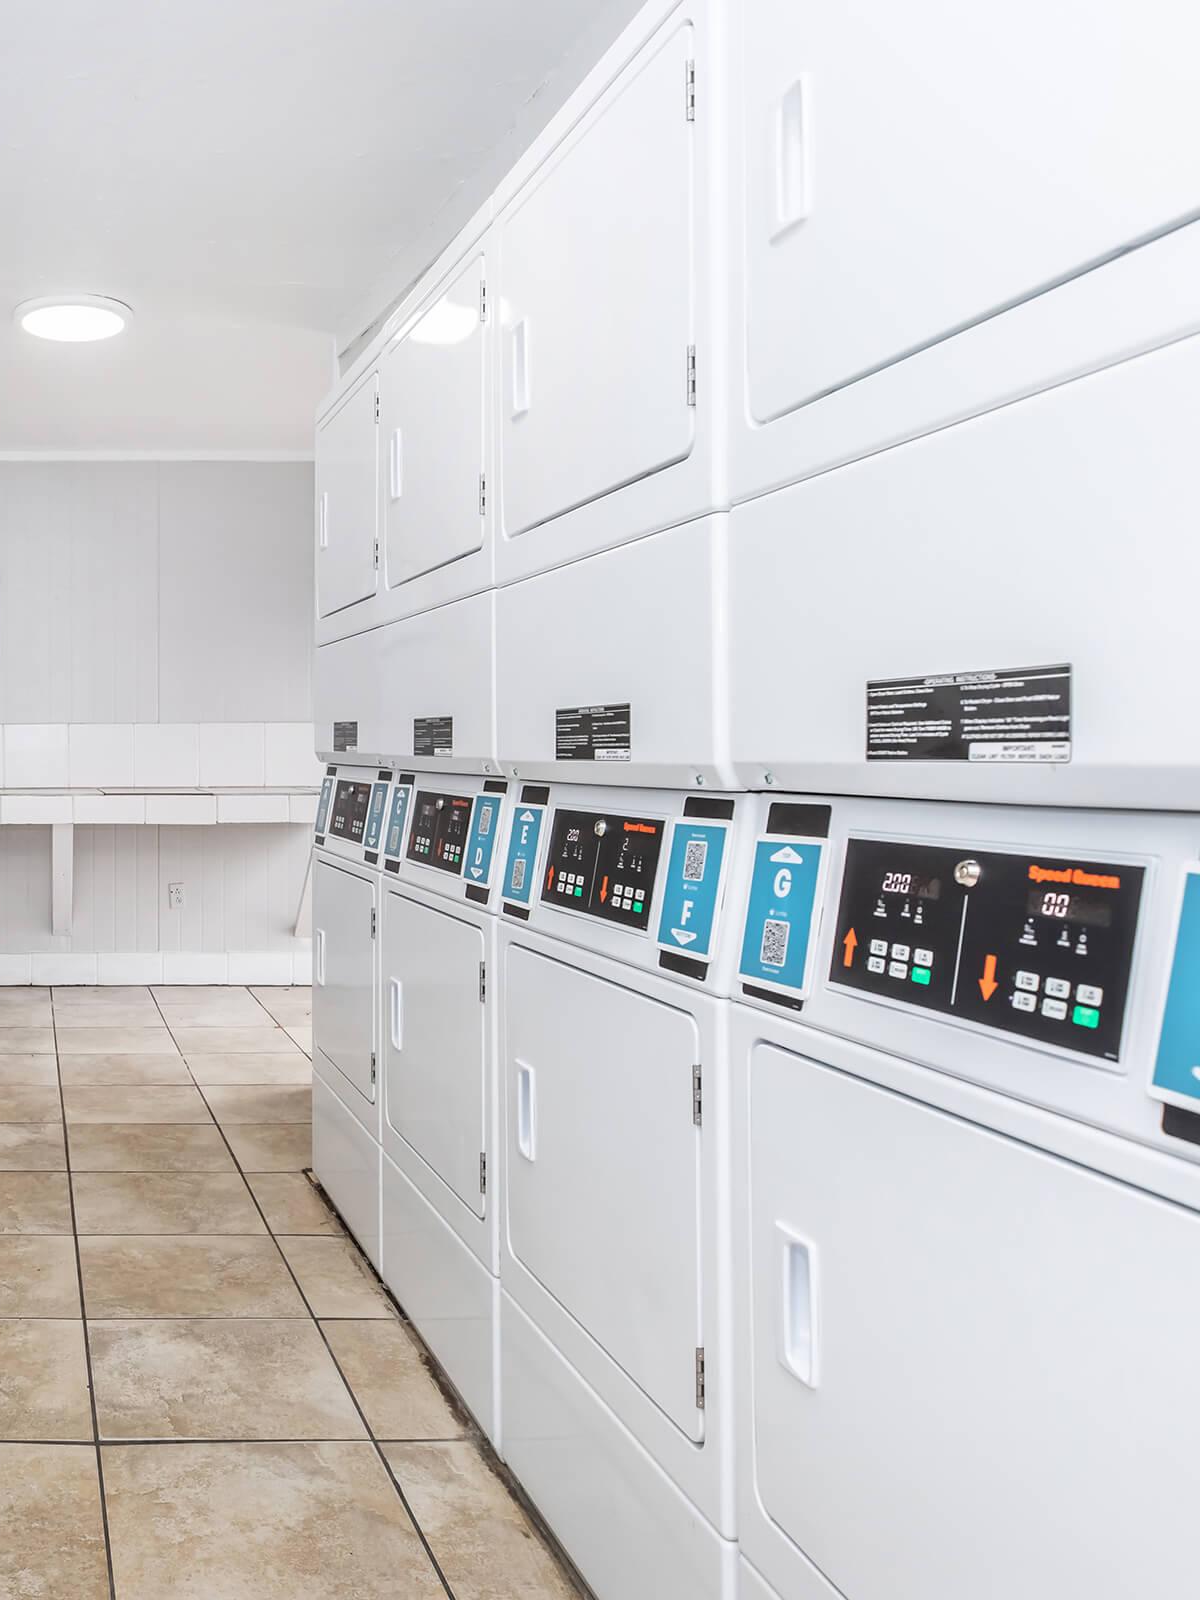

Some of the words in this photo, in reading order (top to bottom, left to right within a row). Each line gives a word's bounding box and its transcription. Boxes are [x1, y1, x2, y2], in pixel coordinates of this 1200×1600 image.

[520, 825, 529, 845] E
[475, 847, 483, 865] D
[773, 868, 792, 898] G
[1028, 864, 1072, 883] Speed
[680, 900, 694, 926] F
